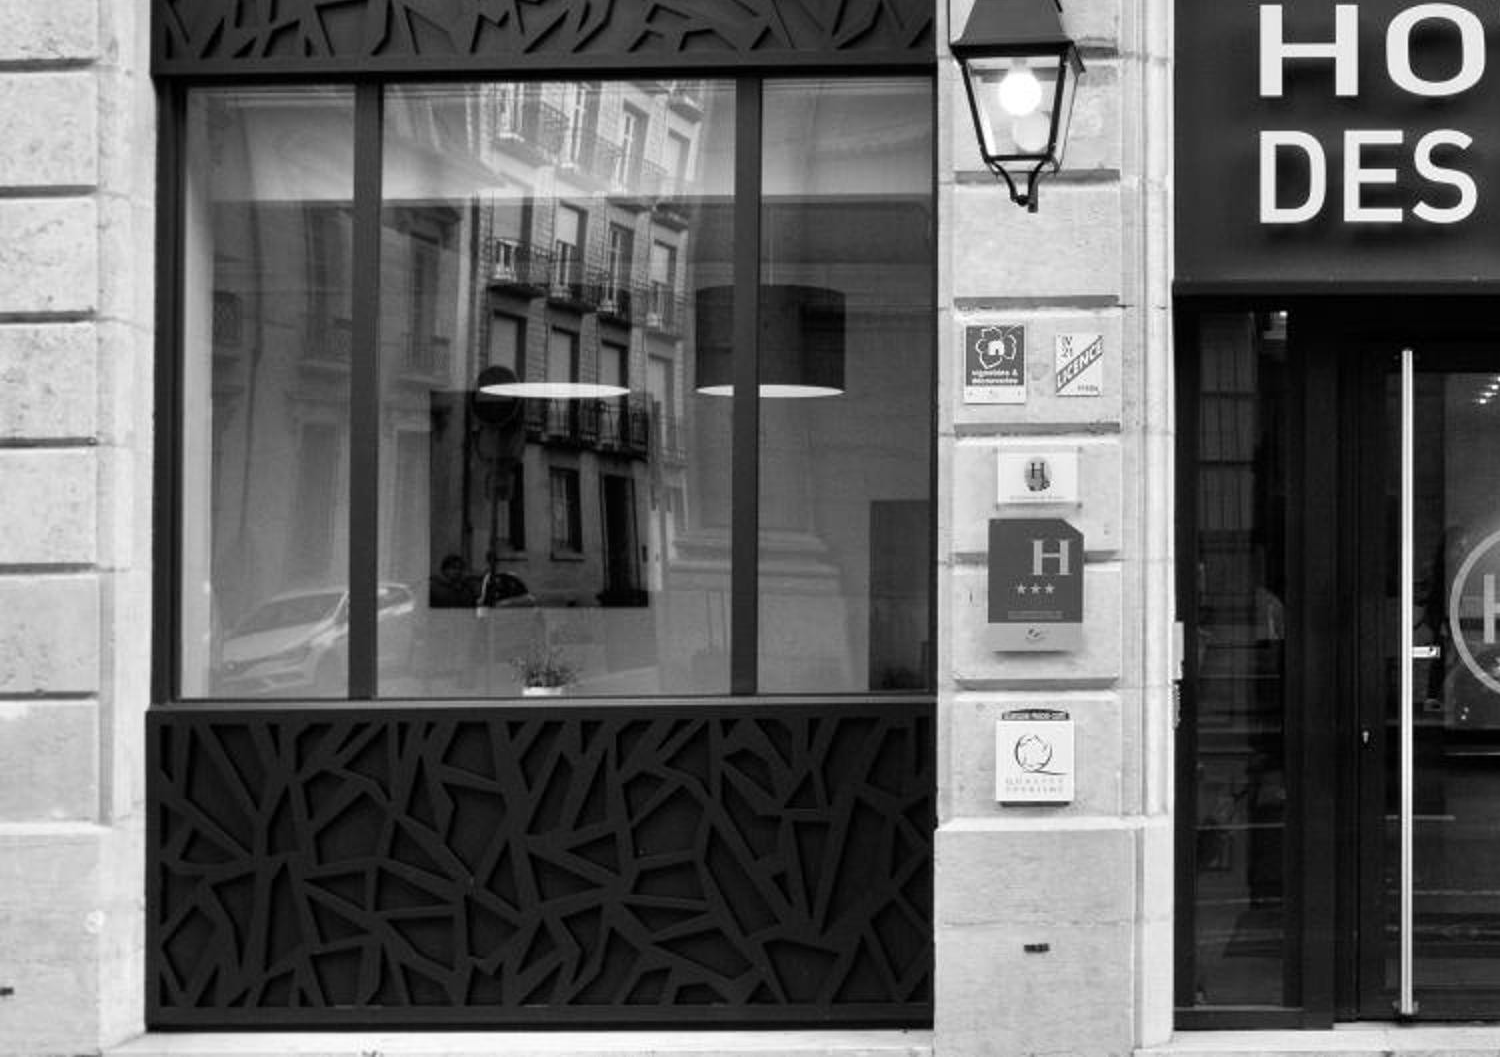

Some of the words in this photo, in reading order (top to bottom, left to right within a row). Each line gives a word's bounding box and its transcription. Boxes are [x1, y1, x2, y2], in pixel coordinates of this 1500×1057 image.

[1259, 129, 1479, 224] DES
[1056, 338, 1103, 389] LICENCE
[1031, 539, 1071, 576] H
